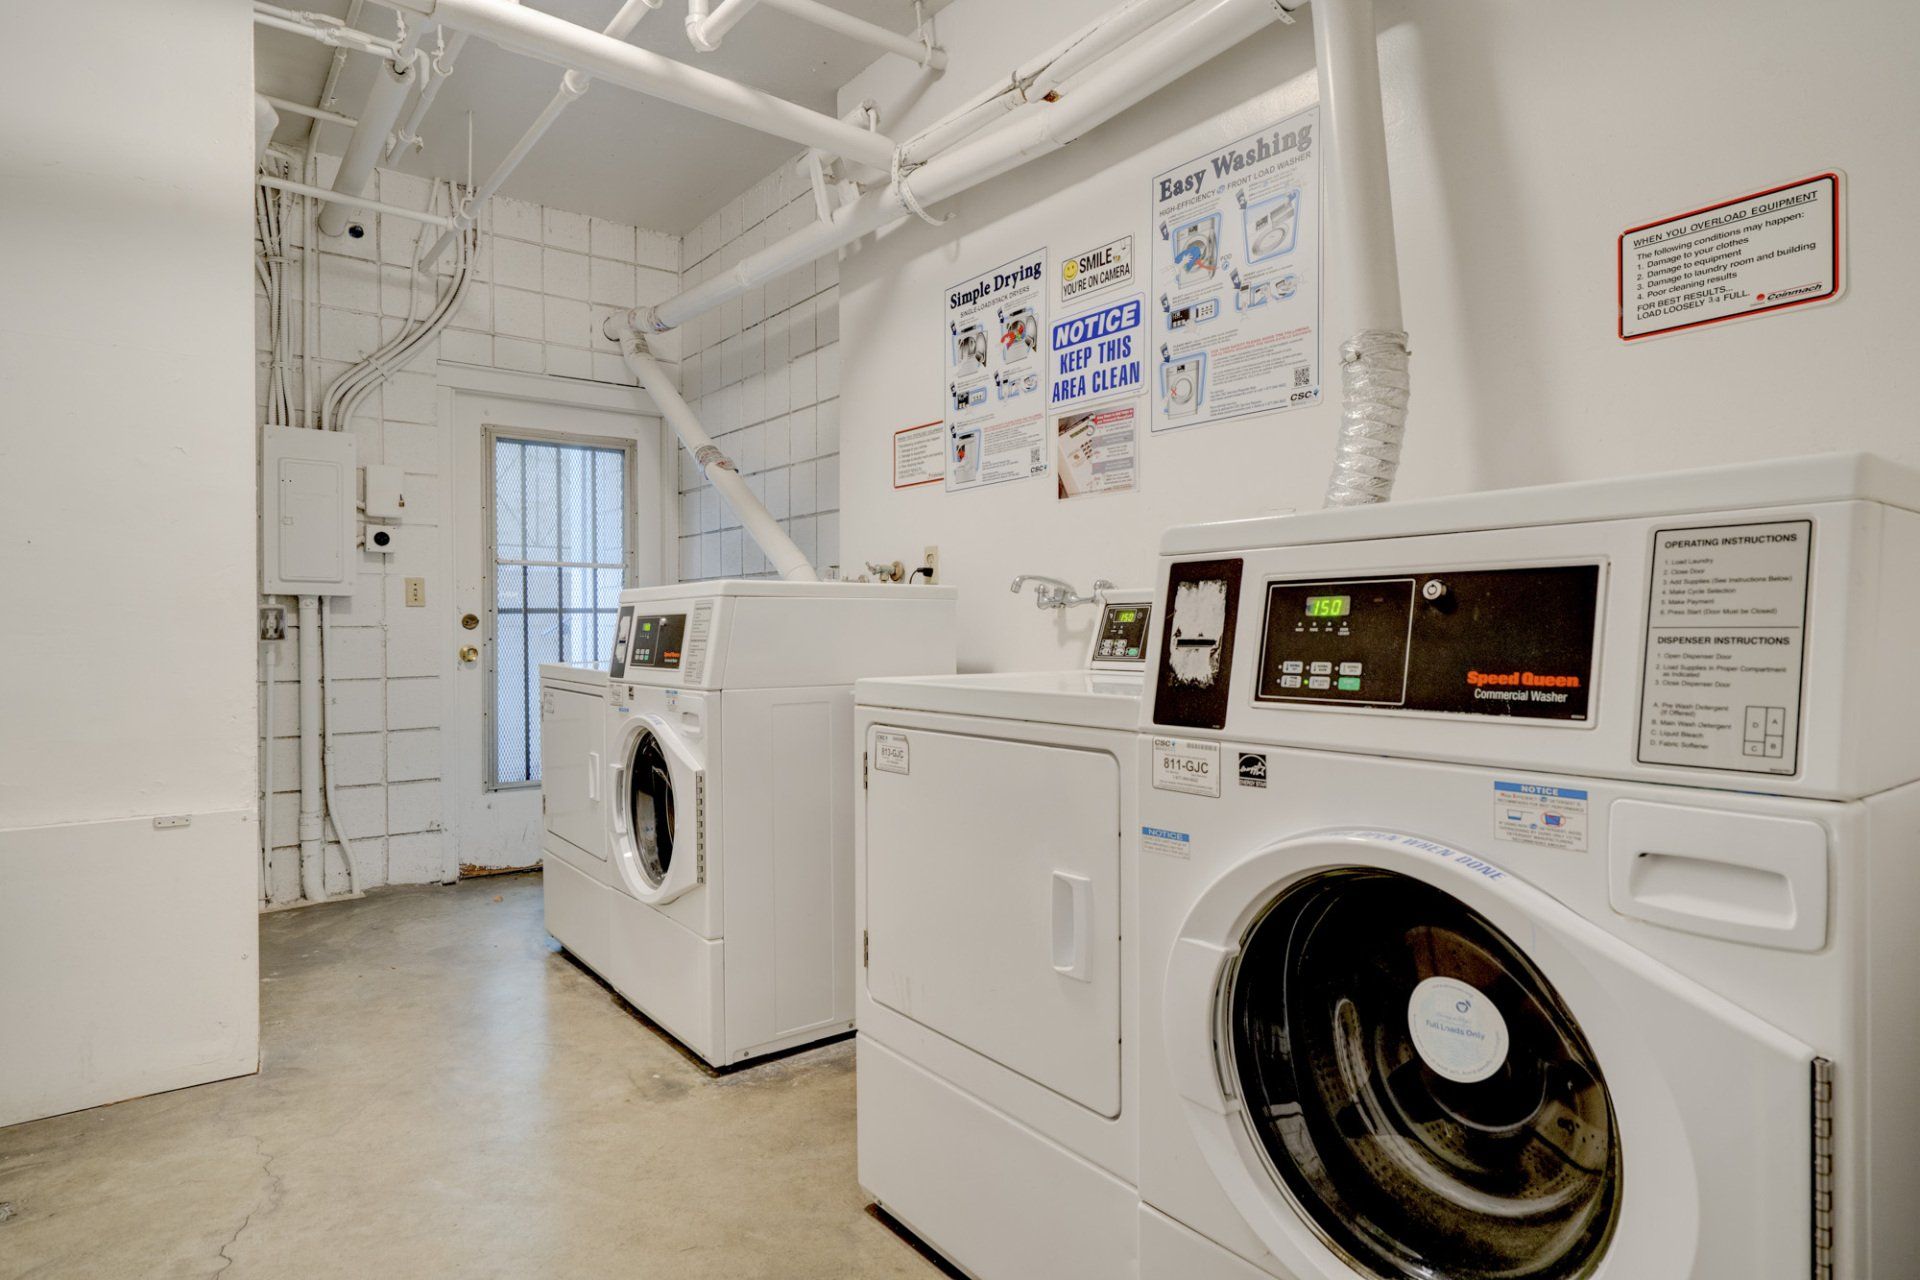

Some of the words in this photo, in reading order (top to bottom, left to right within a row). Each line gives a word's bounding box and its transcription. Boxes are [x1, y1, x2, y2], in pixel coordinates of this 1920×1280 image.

[1159, 169, 1206, 202] Easy
[1211, 124, 1312, 179] Washing
[1160, 190, 1216, 217] HIGH-EFFICIENCY
[1228, 175, 1251, 190] FRONT
[1254, 166, 1275, 179] LOAD
[1277, 151, 1311, 170] WASHER
[1633, 233, 1662, 247] WHEN
[1666, 227, 1686, 238] YOU
[1690, 210, 1746, 231] OVERLOAD
[1752, 191, 1817, 215] EQUIPMENT
[1637, 252, 1651, 260] The
[1654, 241, 1692, 258] following
[1694, 228, 1740, 246] conditions
[1743, 222, 1763, 233] may
[1765, 211, 1804, 228] happen:
[1079, 248, 1112, 273] SMILE
[1647, 255, 1681, 268] Damage
[1694, 247, 1713, 259] your
[1716, 237, 1748, 253] clothes
[1647, 265, 1681, 278] Damage
[1694, 249, 1741, 269] equipment
[1647, 275, 1681, 288] Damage
[1684, 271, 1692, 279] to
[1695, 264, 1728, 278] laundry
[1731, 258, 1754, 267] room
[1756, 252, 1774, 262] and
[1777, 242, 1816, 258] building
[950, 281, 990, 309] Simple
[994, 262, 1042, 291] Drying
[1064, 278, 1086, 296] YOU'RE
[1088, 275, 1098, 286] ON
[1100, 263, 1130, 284] CAMERA
[1647, 288, 1667, 297] Poor
[1669, 280, 1705, 294] cleaning
[1707, 271, 1737, 283] results
[1009, 286, 1029, 300] DRYERS
[1637, 303, 1655, 312] FOR
[1658, 296, 1680, 307] BEST
[1683, 286, 1733, 303] RESULTS...
[1767, 283, 1822, 300] Coinmach
[1637, 310, 1661, 320] LOAD
[1664, 300, 1705, 315] LOOSELY
[1055, 303, 1137, 348] NOTICE
[1060, 346, 1092, 374] KEEP
[1098, 335, 1131, 363] THIS
[1052, 375, 1085, 403] AREA
[1093, 361, 1139, 393] CLEAN
[1290, 391, 1312, 401] CSC
[1665, 538, 1719, 549] OPERATING
[1722, 533, 1797, 545] INSTRUCTIONS
[1683, 578, 1710, 586] Supplies
[1314, 599, 1341, 615] 150
[1714, 637, 1790, 645] INSTRUCTIONS
[1467, 671, 1519, 687] Speed
[1522, 672, 1579, 687] Queen
[1474, 688, 1528, 700] Commercial
[1531, 691, 1568, 702] Washer
[1695, 704, 1728, 712] Detergent
[1698, 722, 1731, 730] Detergent
[1155, 739, 1170, 747] CSC
[1164, 758, 1208, 774] 811-GJC
[1521, 785, 1559, 795] NOTICE
[1148, 829, 1183, 840] NOTICE
[1402, 838, 1456, 856] WHEN
[1455, 856, 1506, 880] DONE
[1426, 1020, 1438, 1029] Full
[1441, 1023, 1464, 1036] Loads
[1466, 1030, 1485, 1040] Only
